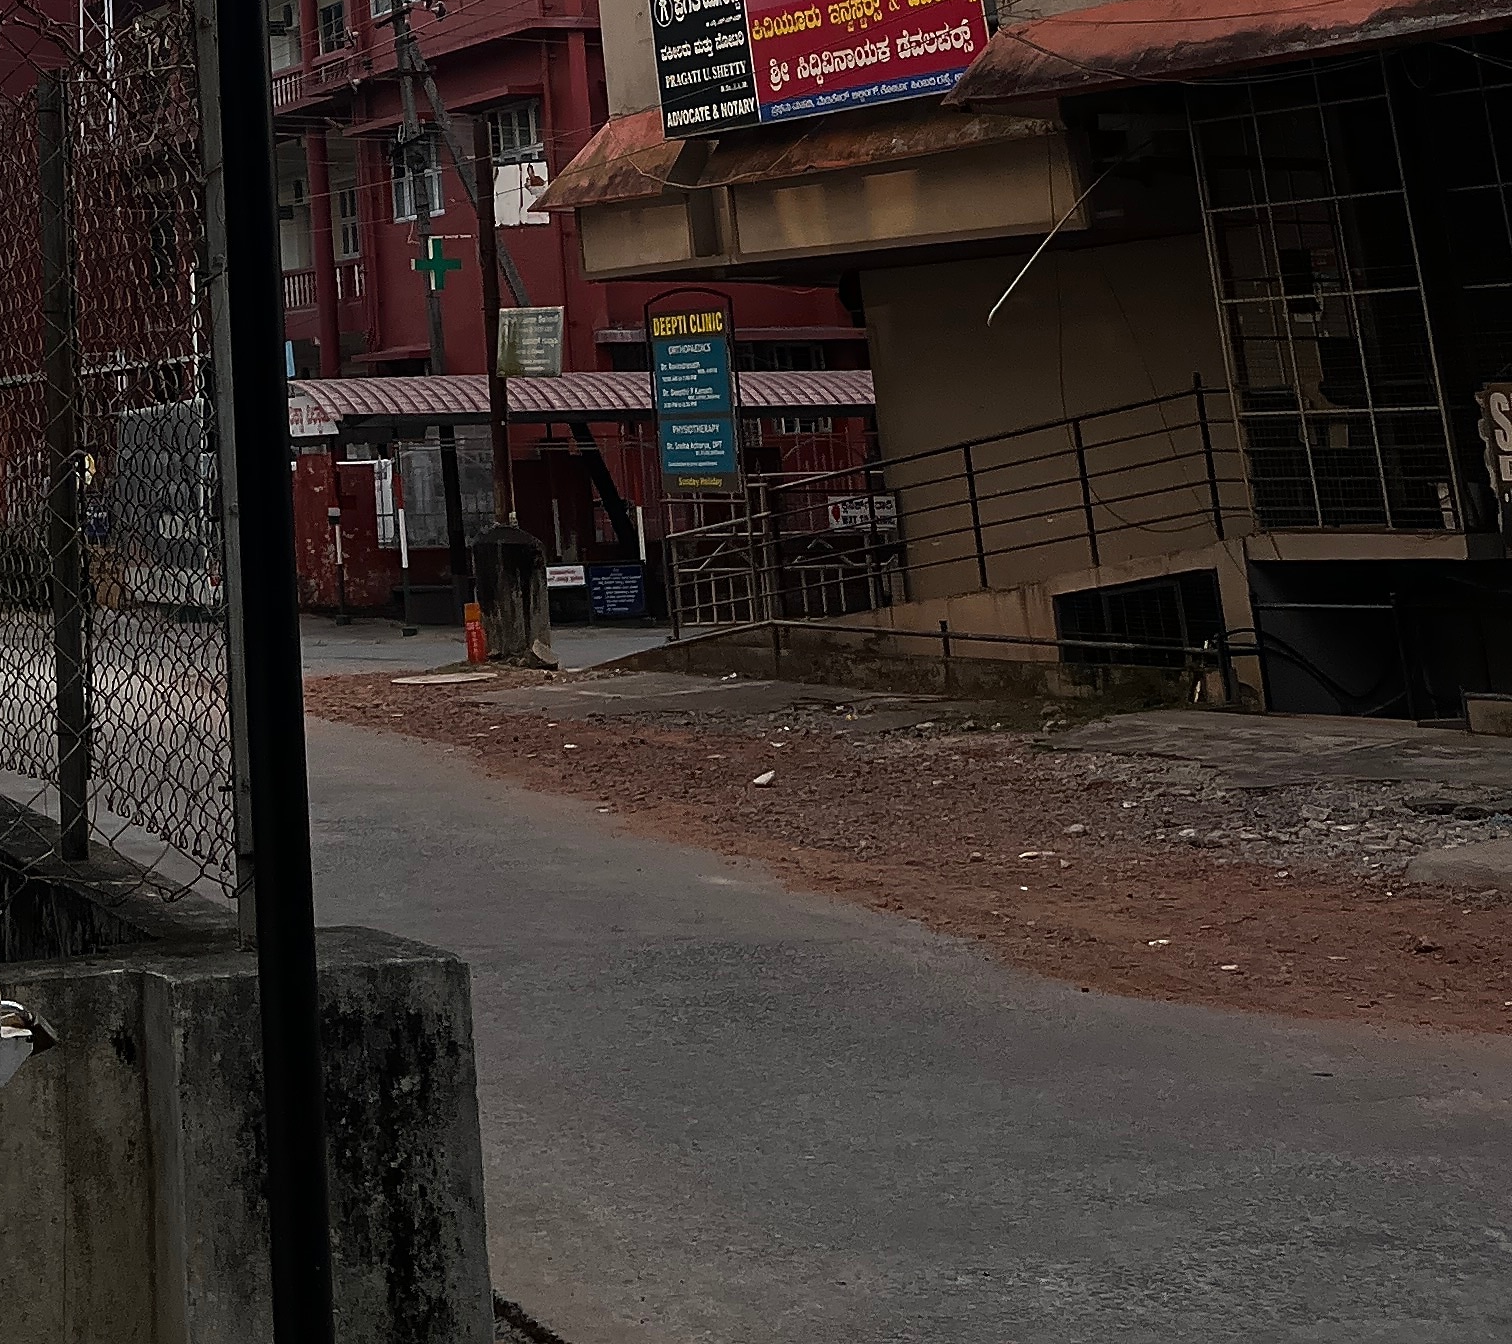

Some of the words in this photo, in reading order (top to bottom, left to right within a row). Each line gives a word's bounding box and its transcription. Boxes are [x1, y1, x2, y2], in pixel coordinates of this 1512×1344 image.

[665, 69, 701, 89] PRAGATI
[712, 61, 747, 82] SHETTY
[667, 105, 712, 128] ADVOCATE
[721, 98, 756, 117] NOTARY
[652, 316, 687, 337] DEEPTI
[689, 311, 723, 334] CLINIC
